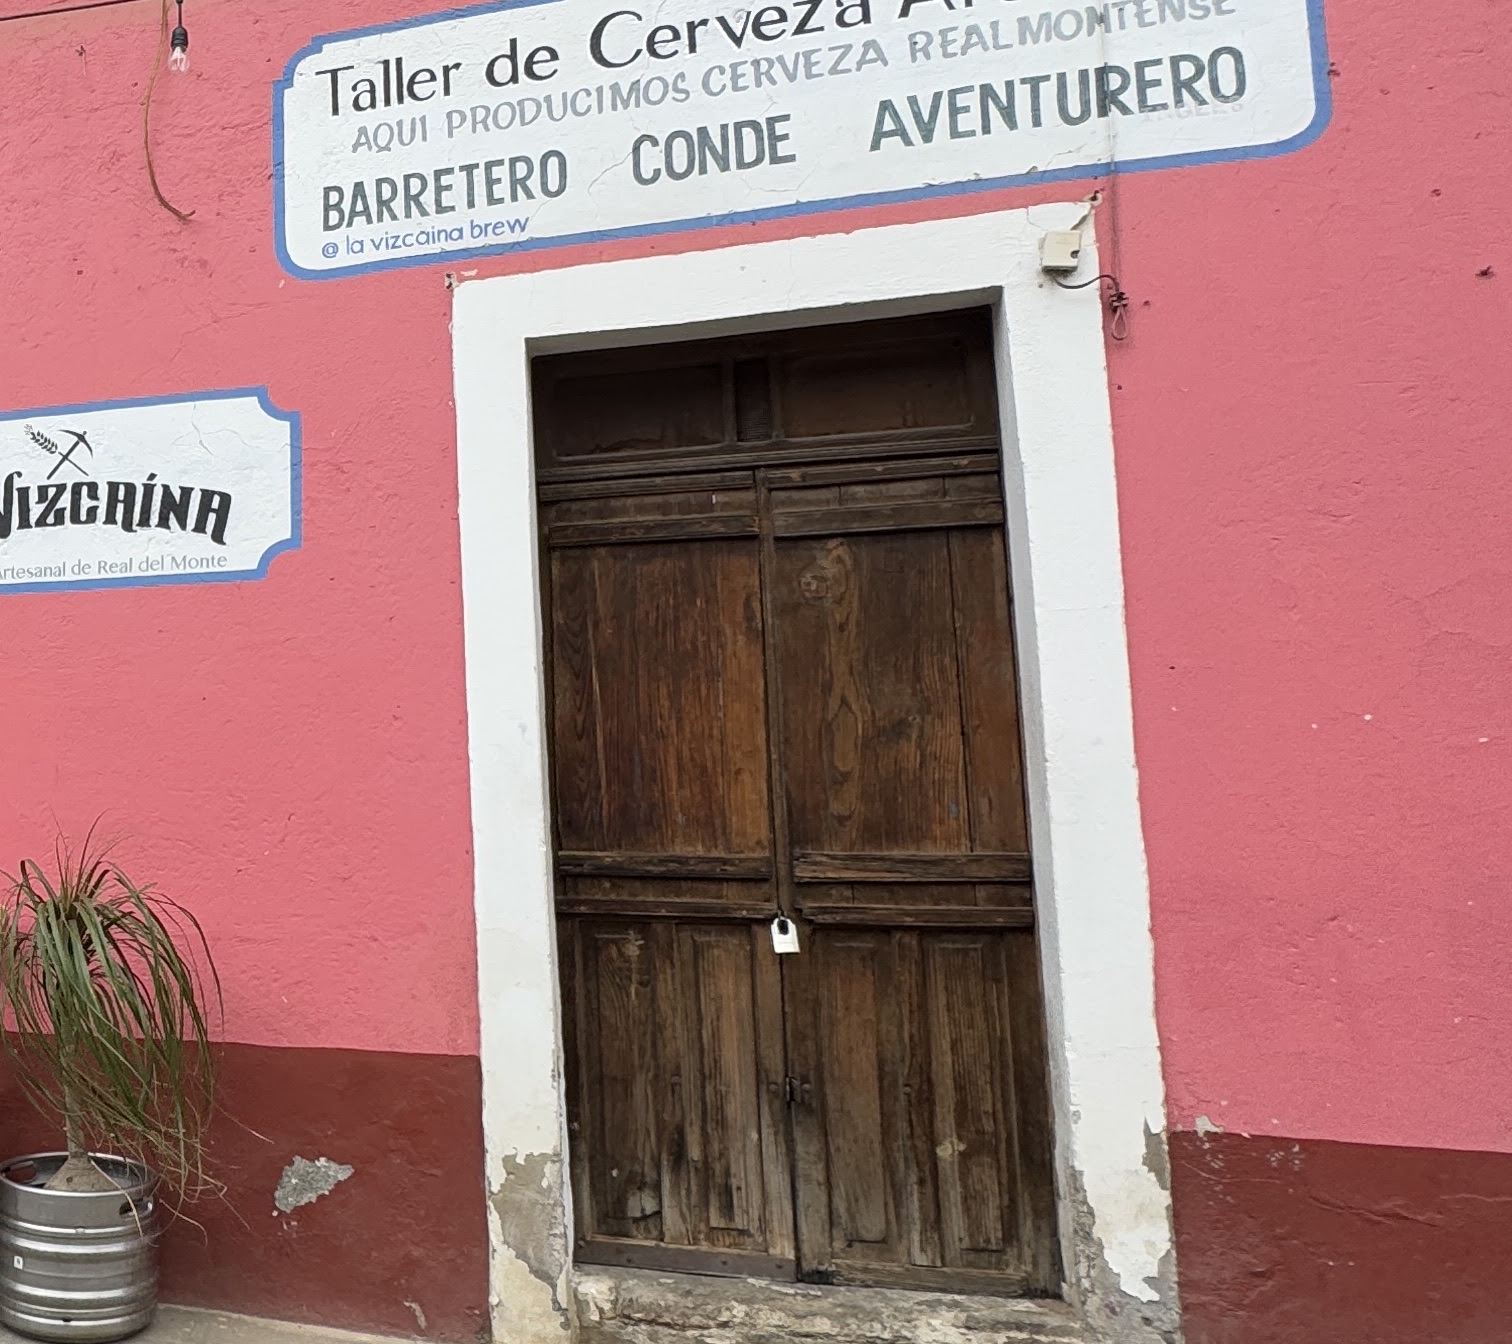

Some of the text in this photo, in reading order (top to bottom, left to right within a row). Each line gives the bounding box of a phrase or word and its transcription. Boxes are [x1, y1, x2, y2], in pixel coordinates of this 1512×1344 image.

[315, 58, 462, 117] Taller
[485, 37, 560, 88] de
[351, 114, 428, 154] AQUI
[445, 70, 691, 139] PRODUCIMOS
[701, 38, 889, 97] CERVEZA
[322, 45, 1247, 232] BARRETERO CONDE AVENTURERO
[345, 234, 365, 256] la
[369, 225, 465, 252] vizcaina
[469, 214, 531, 239] brew
[70, 558, 92, 576] de
[97, 557, 133, 575] Real
[137, 555, 165, 572] del
[169, 554, 228, 571] Monte
